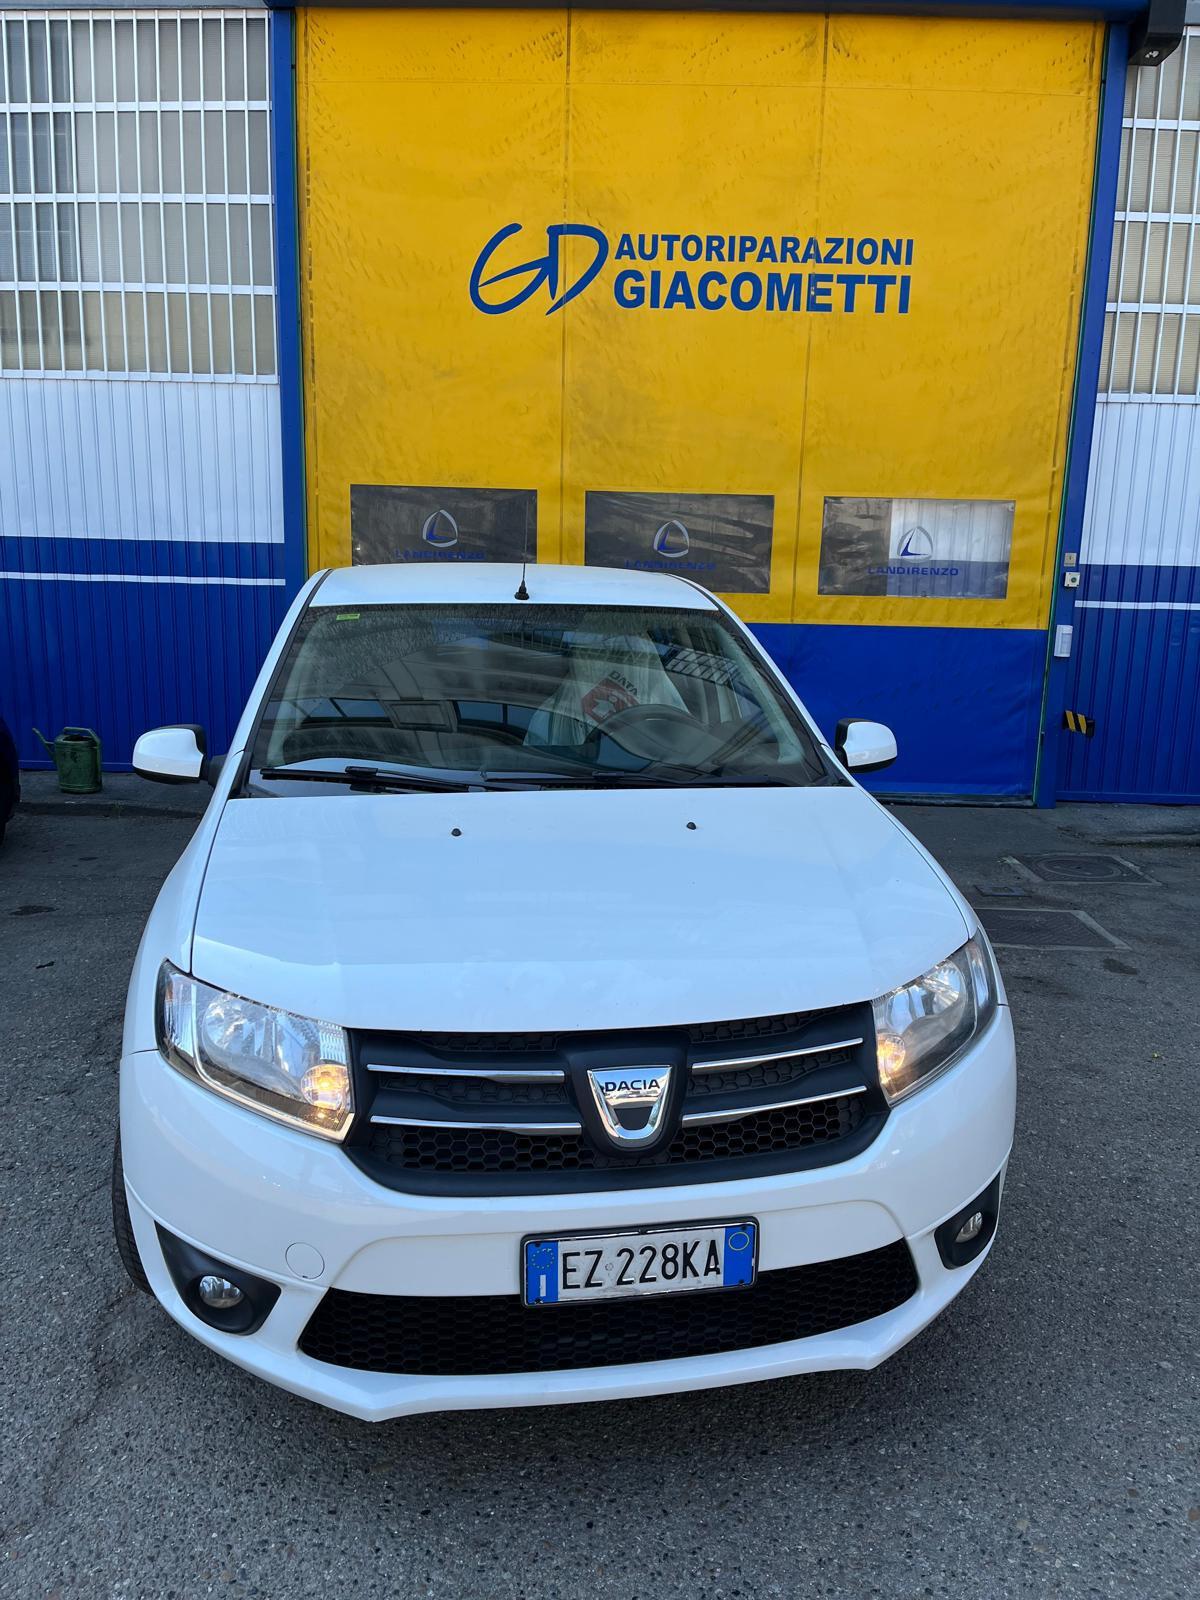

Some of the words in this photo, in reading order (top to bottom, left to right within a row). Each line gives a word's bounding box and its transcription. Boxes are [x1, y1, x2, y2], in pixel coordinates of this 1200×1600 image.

[615, 233, 914, 266] AUTORIPARAZIONI
[613, 269, 911, 314] GIACOMETTI
[867, 566, 959, 576] LANDIRENZO
[604, 1078, 661, 1093] DACIA
